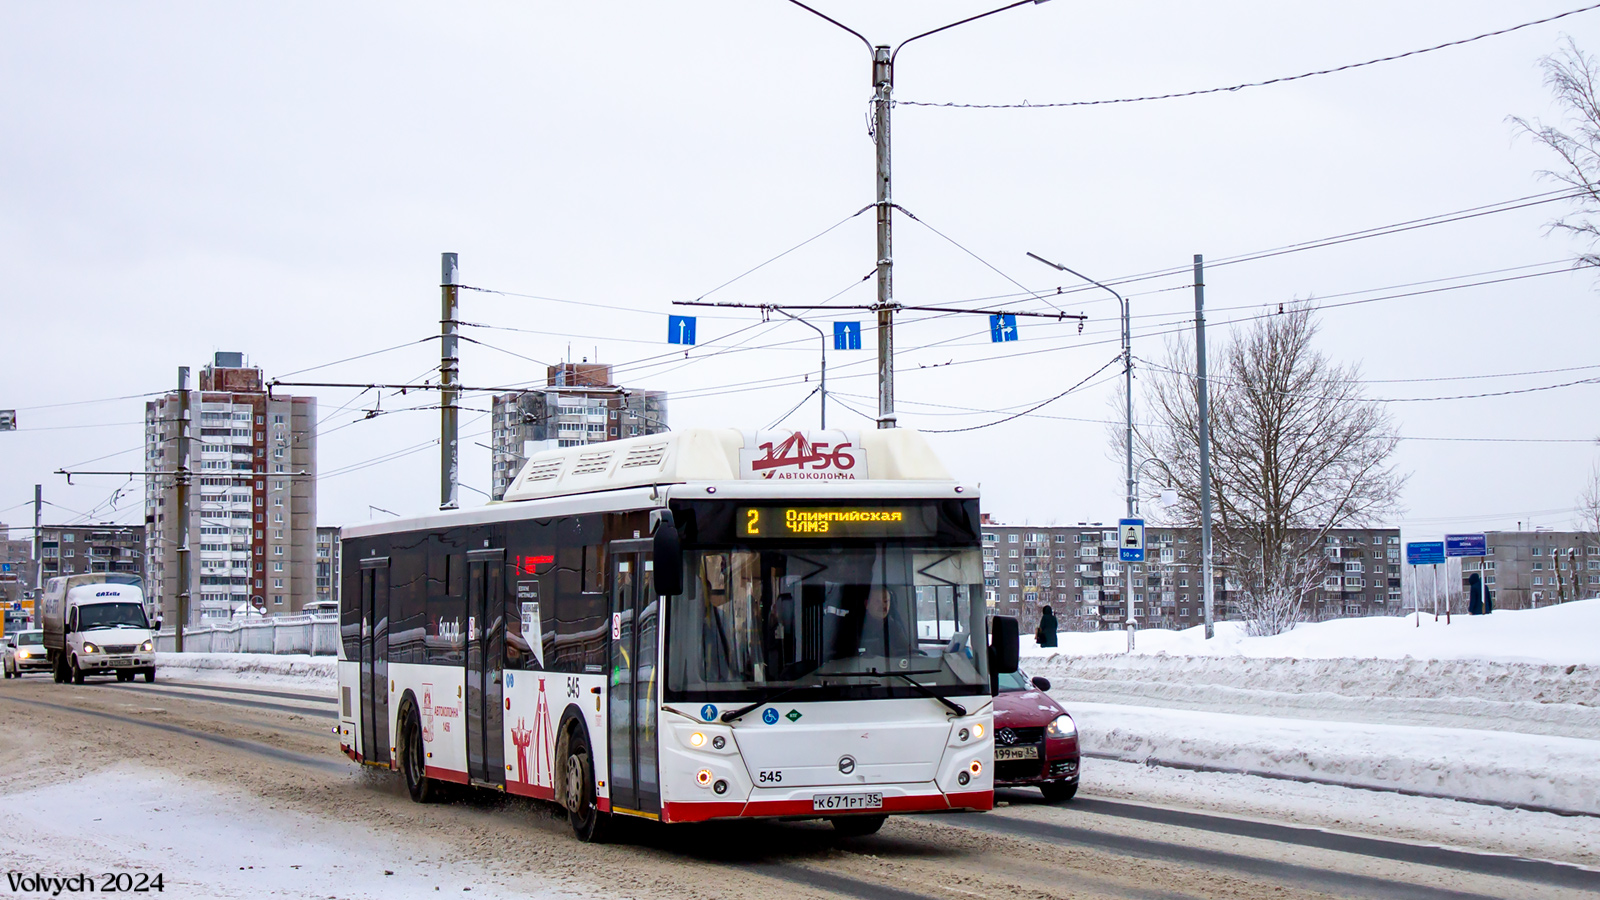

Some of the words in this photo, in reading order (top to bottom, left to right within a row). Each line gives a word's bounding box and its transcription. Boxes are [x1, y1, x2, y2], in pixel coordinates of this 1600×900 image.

[779, 472, 855, 480] АВТОКОЛОННА
[747, 509, 760, 534] 2
[786, 509, 902, 521] Олимпийская
[786, 520, 829, 532] ЧЛМЗ
[567, 676, 580, 699] 545
[759, 771, 782, 782] 545
[818, 796, 863, 808] К671РТ
[867, 794, 878, 804] 35
